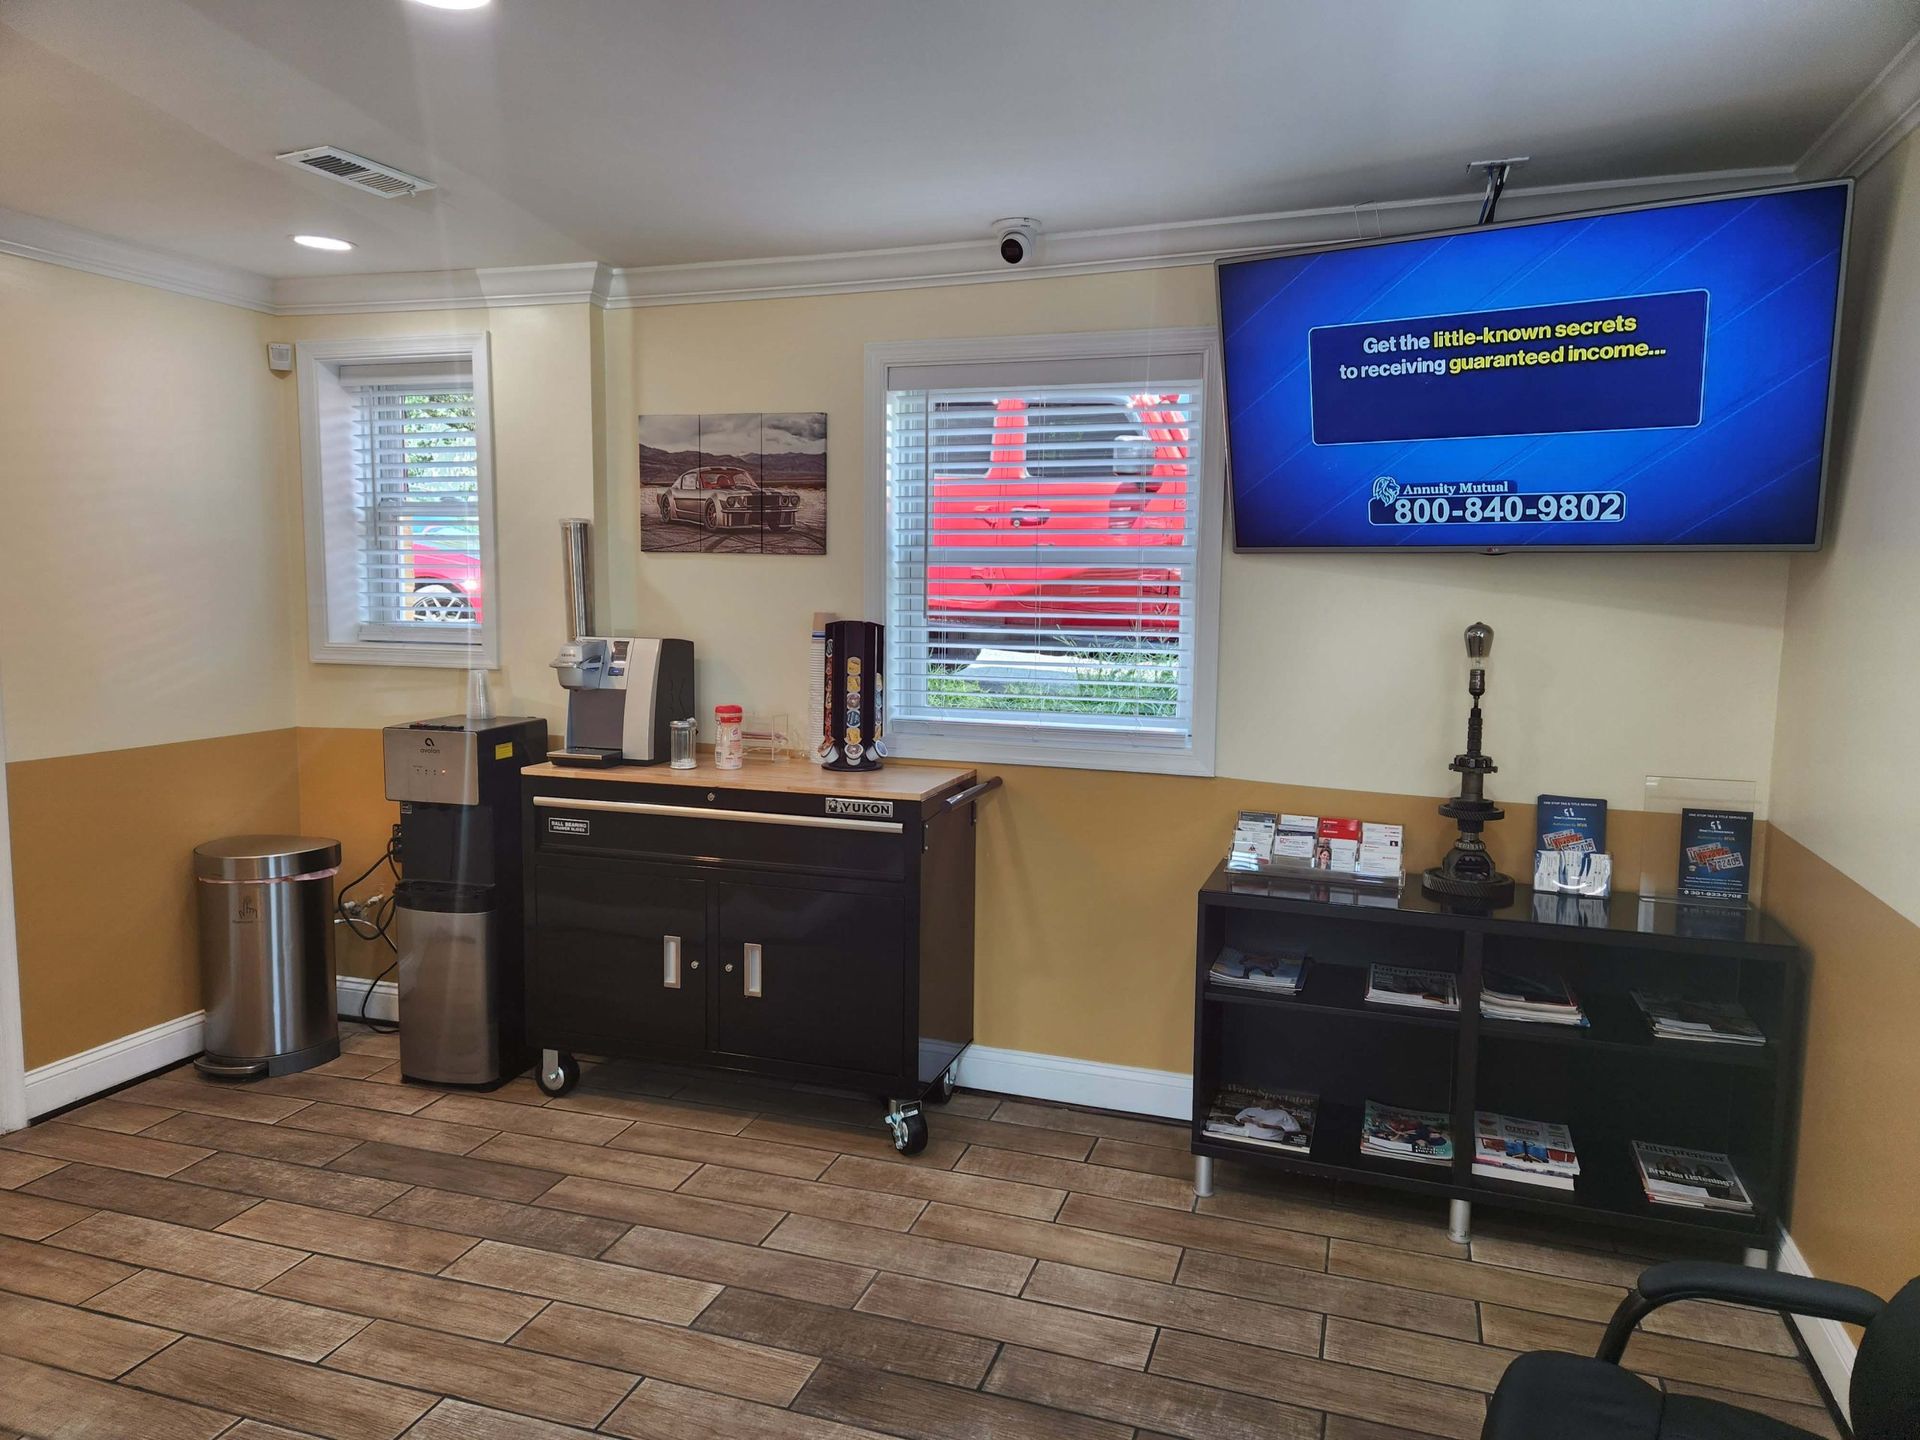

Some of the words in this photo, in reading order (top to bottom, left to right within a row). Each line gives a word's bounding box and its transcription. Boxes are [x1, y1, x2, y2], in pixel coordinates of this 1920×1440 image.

[1363, 337, 1397, 354] Get
[1399, 334, 1430, 351] the
[1433, 325, 1551, 348] little-known
[1555, 314, 1637, 338] secrets
[1339, 363, 1357, 380] to
[1361, 355, 1446, 378] receiving
[1449, 347, 1565, 374] guaranteed
[1568, 342, 1666, 363] income...
[1403, 481, 1456, 495] Annuity
[1459, 480, 1509, 494] Mutual
[1394, 492, 1622, 523] 800-840-9802
[842, 803, 890, 814] YUKON
[1635, 1141, 1725, 1162] Entrepreneur
